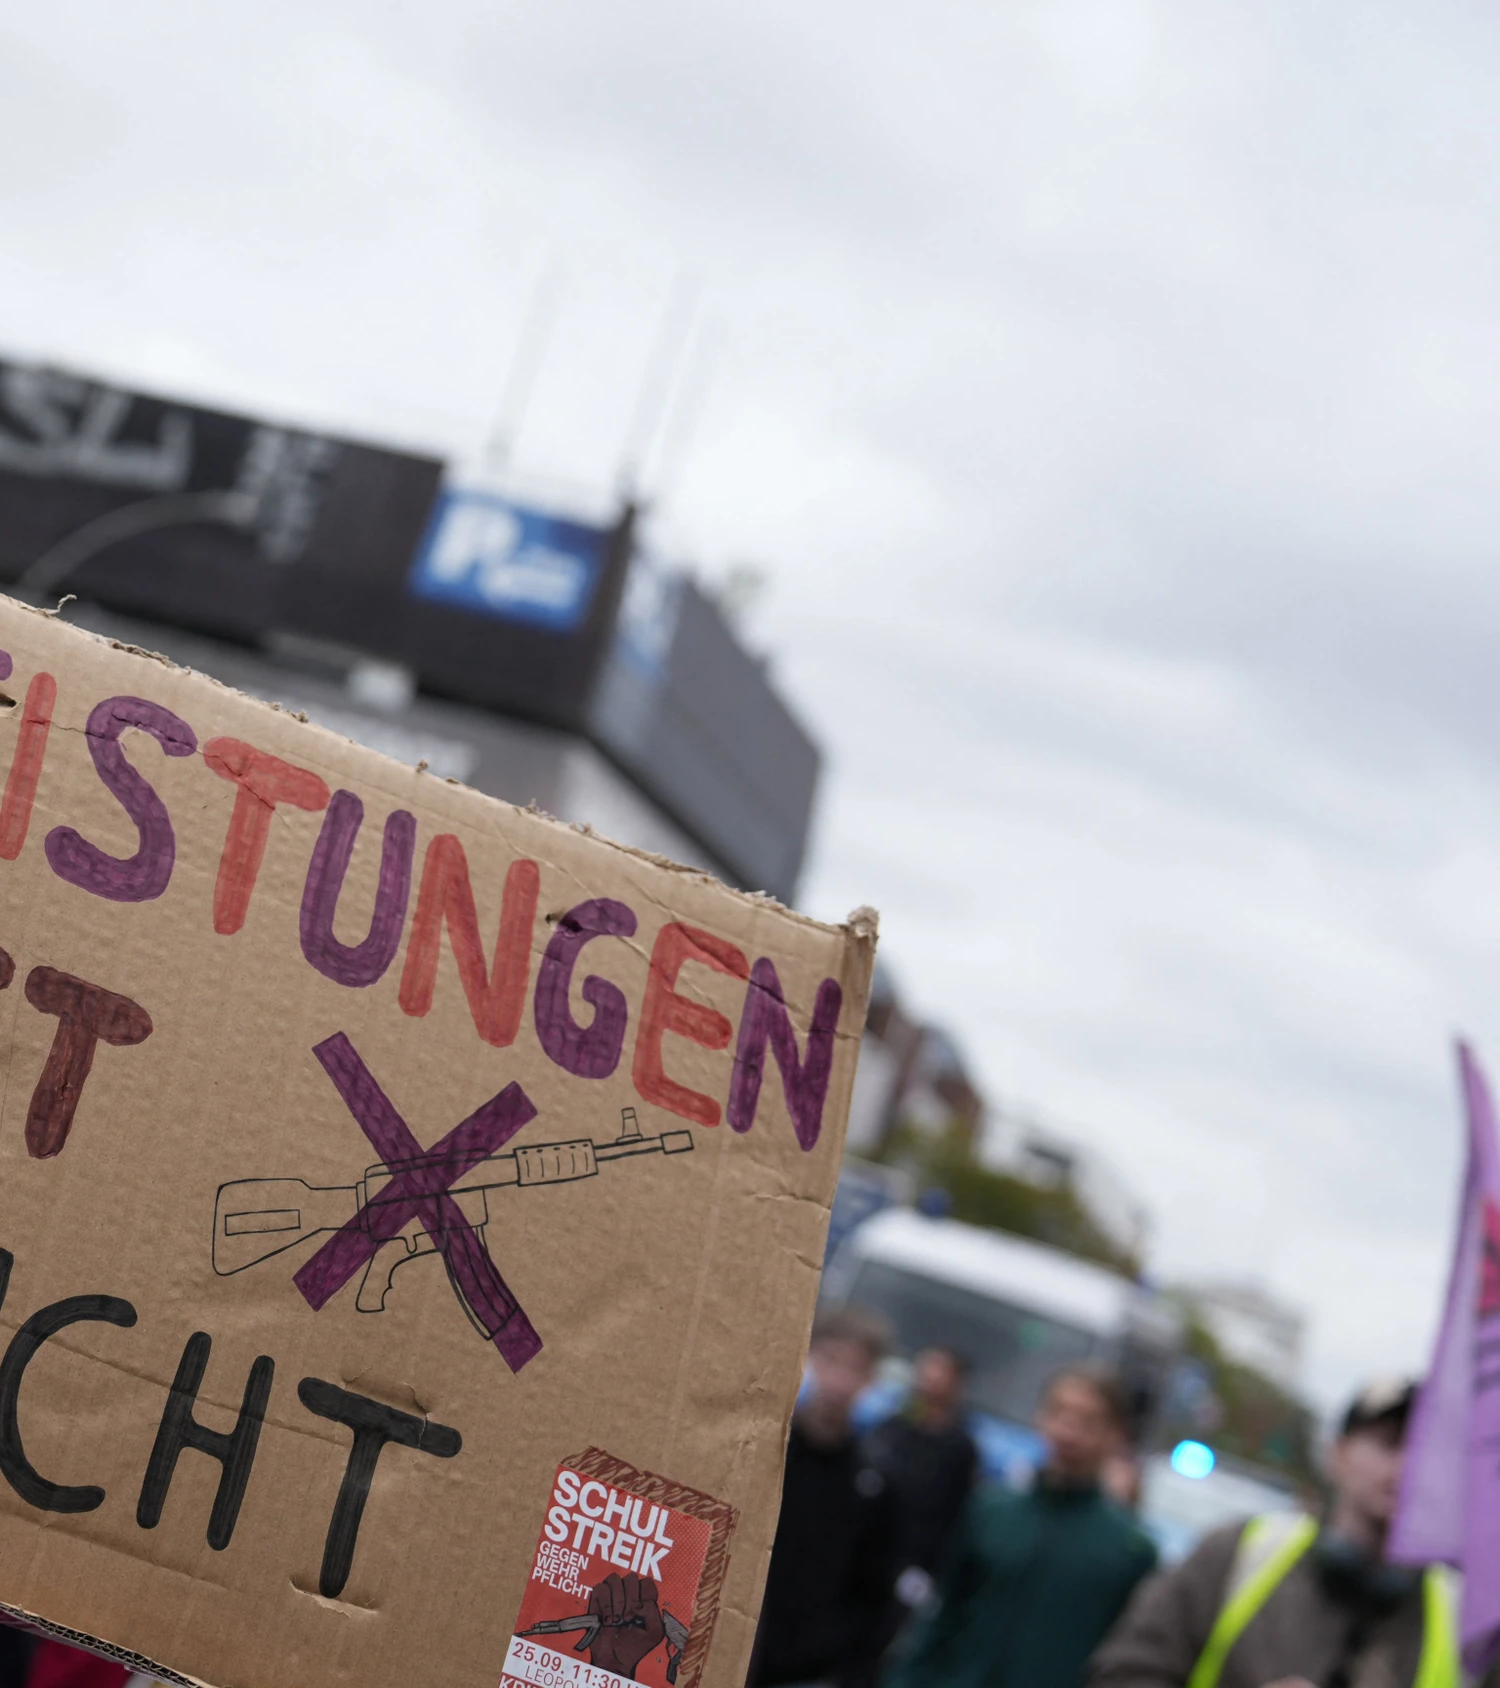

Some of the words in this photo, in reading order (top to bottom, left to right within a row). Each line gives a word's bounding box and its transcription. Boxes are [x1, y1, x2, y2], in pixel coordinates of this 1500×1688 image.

[553, 1470, 674, 1547] SCHUL
[539, 1541, 589, 1570] GEGEN
[544, 1506, 670, 1583] STREIK
[531, 1569, 593, 1600] PFLICHT
[536, 1553, 580, 1582] WEHR
[512, 1642, 564, 1674] 25.09.
[573, 1664, 621, 1688] 11:30
